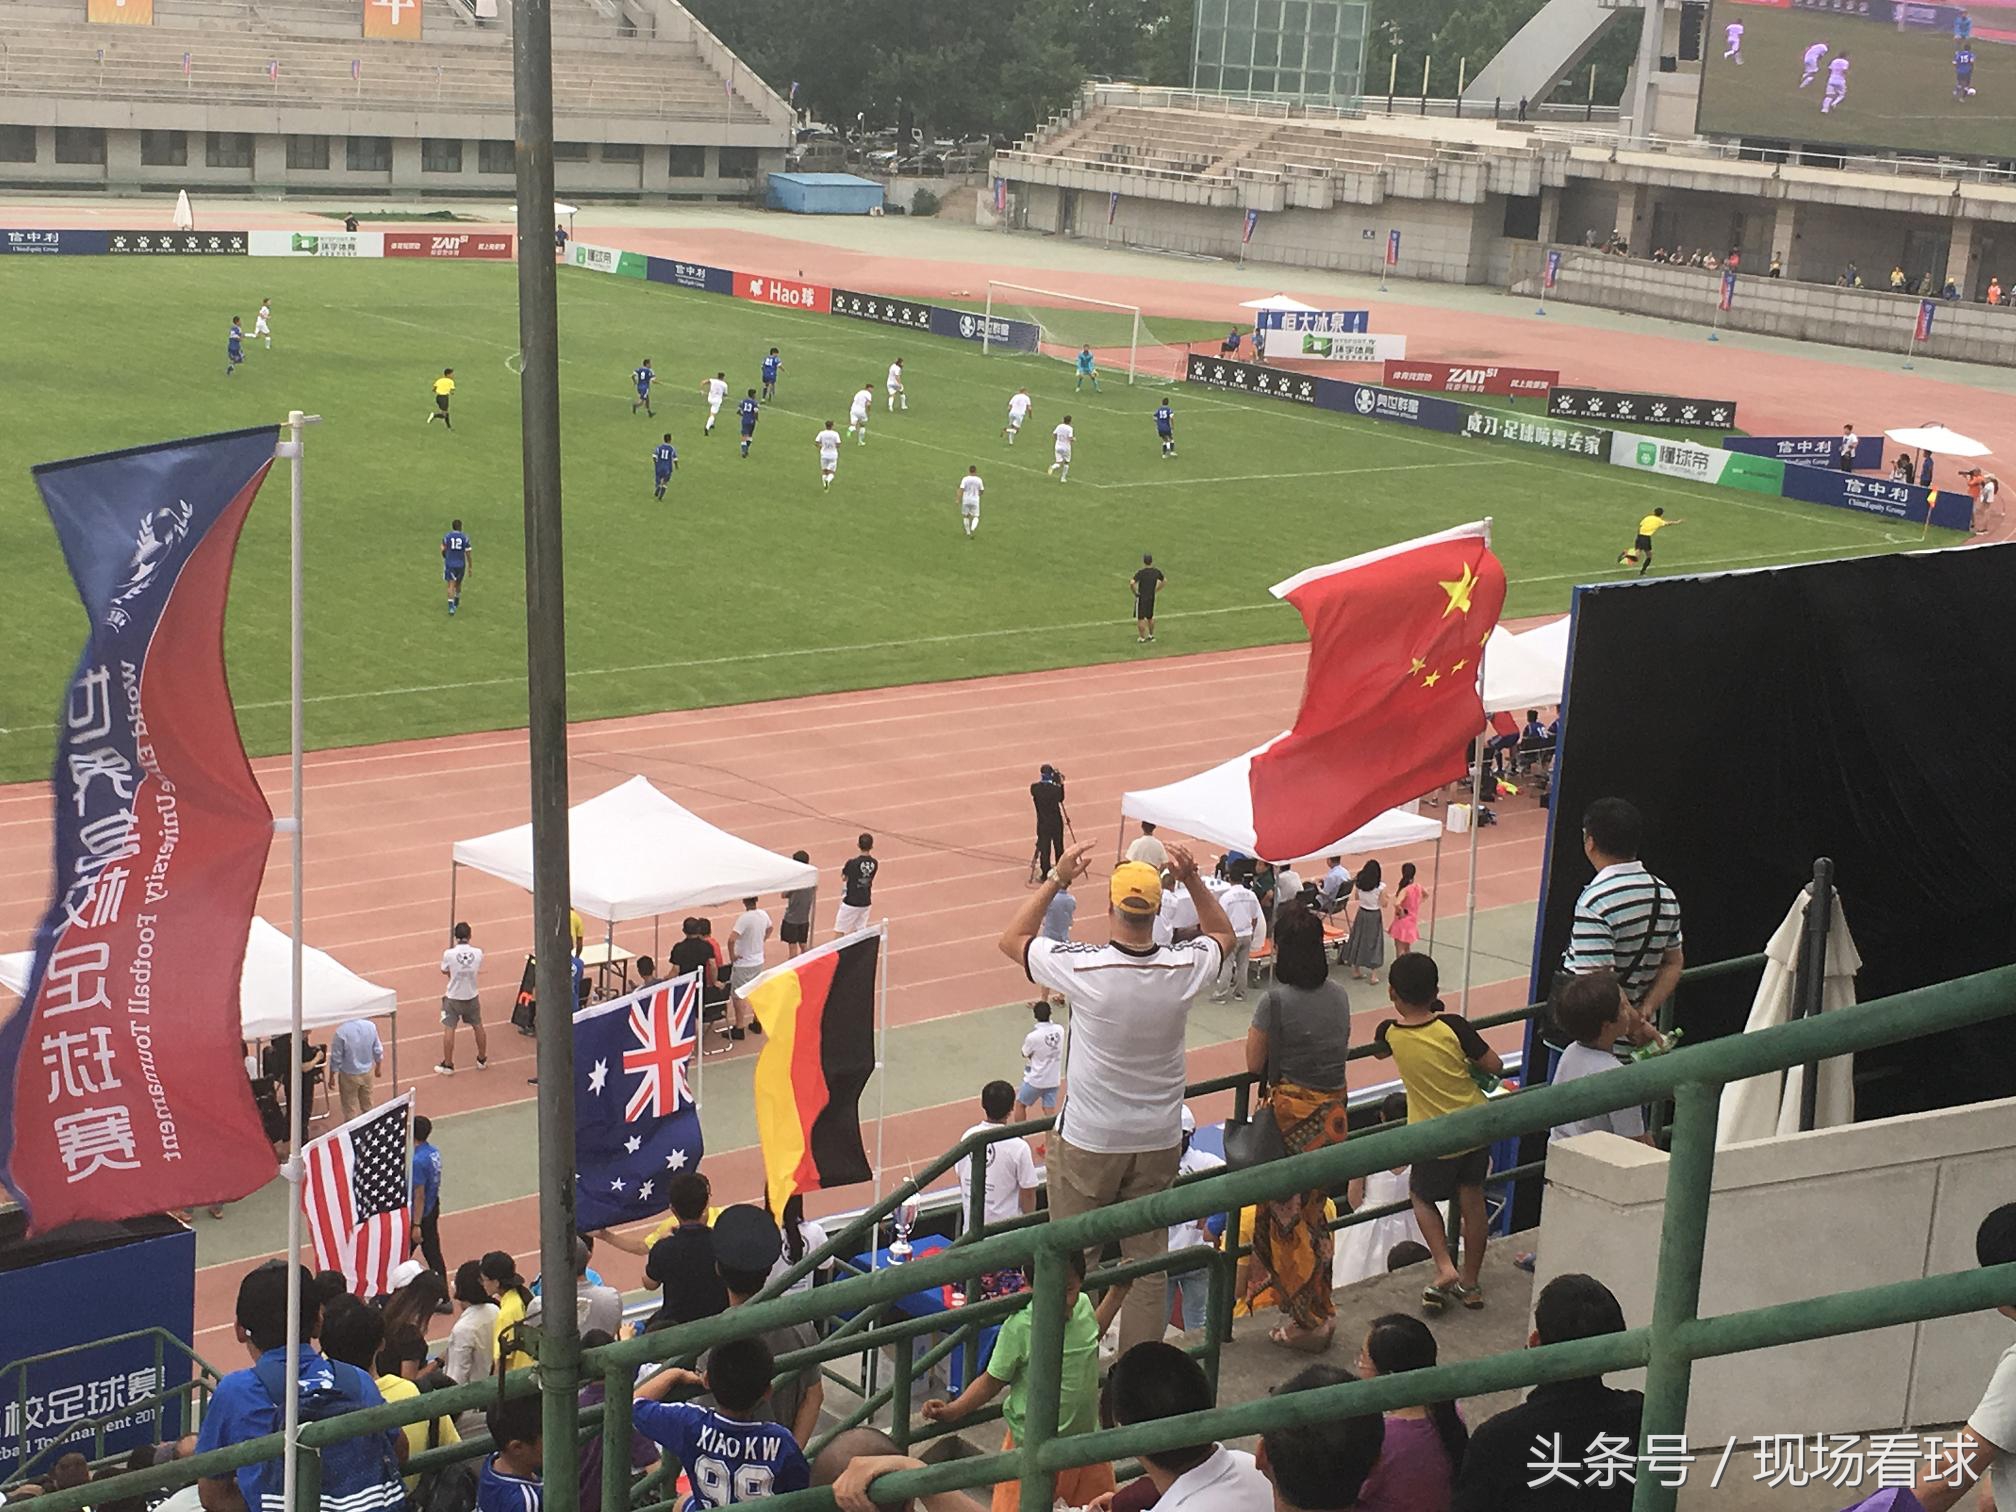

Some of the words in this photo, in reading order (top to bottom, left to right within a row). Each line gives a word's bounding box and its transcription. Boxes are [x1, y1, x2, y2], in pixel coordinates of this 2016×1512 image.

[1281, 312, 1345, 332] 恒大冰泉
[1777, 440, 1831, 453] 信中利
[661, 449, 669, 460] 11
[1844, 479, 1909, 502] 信中利
[450, 537, 463, 550] 12
